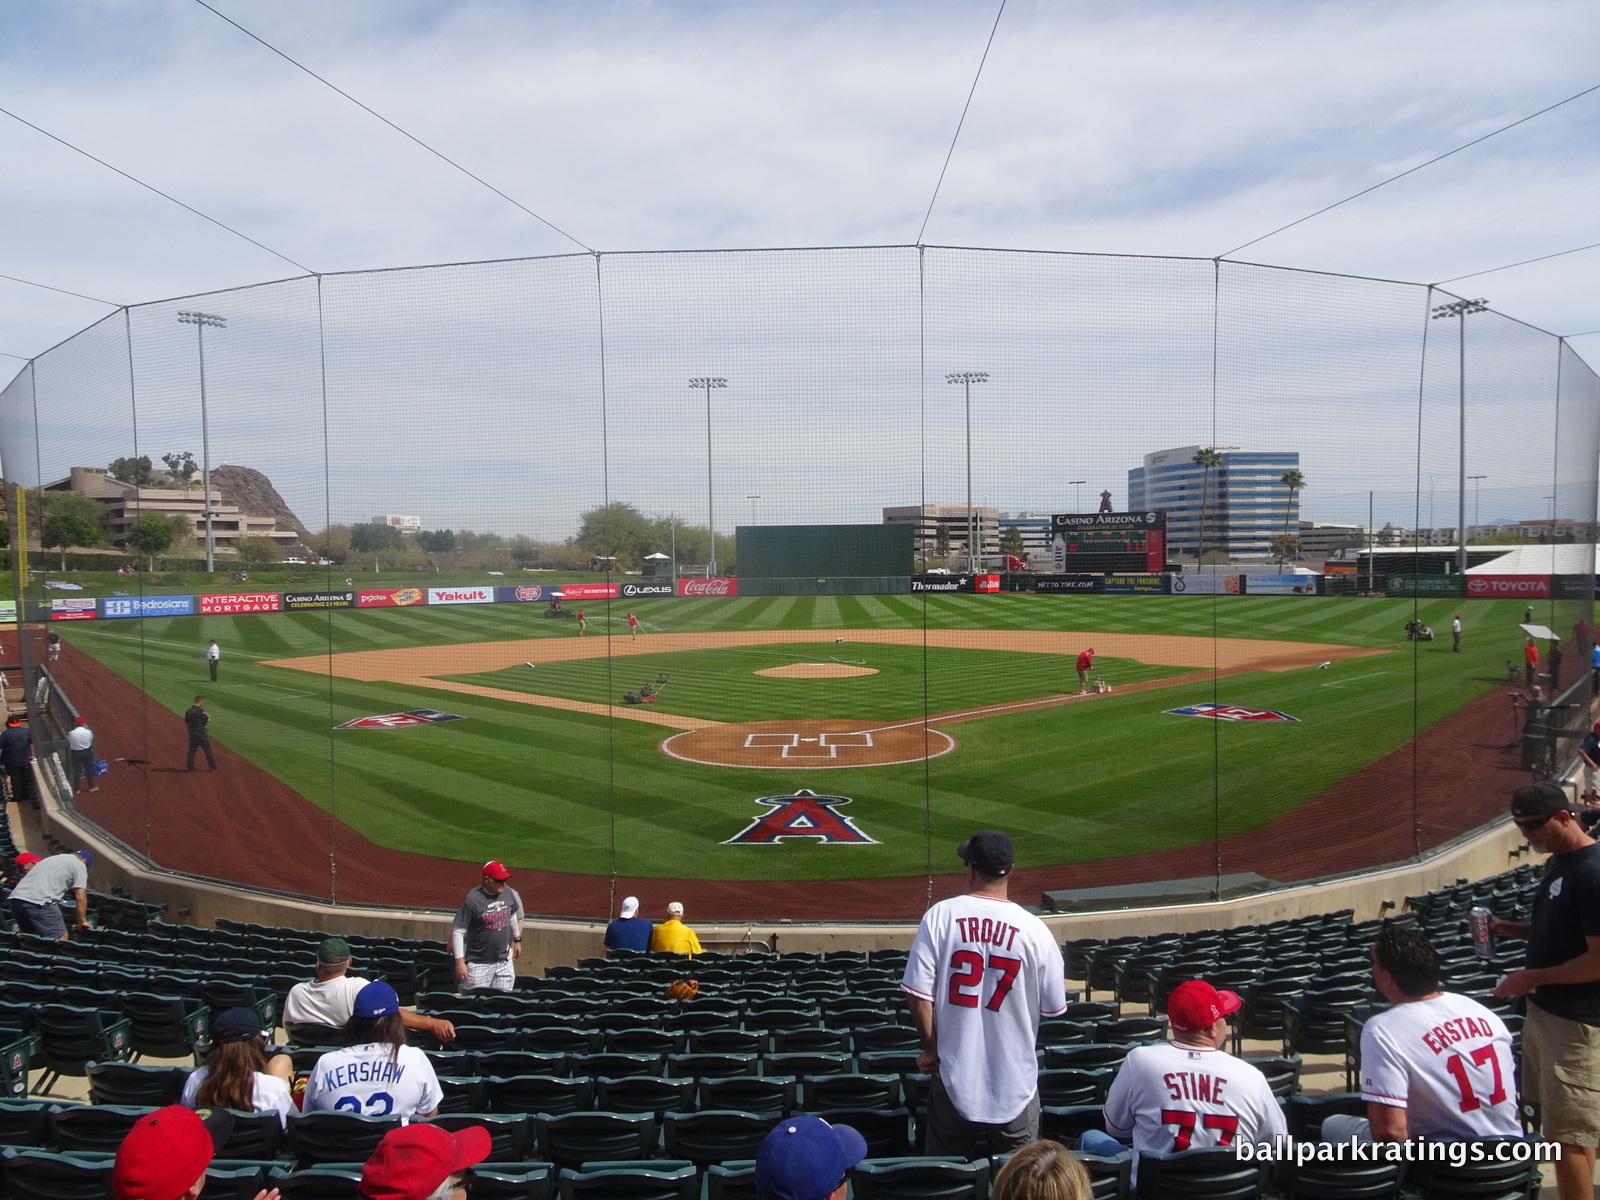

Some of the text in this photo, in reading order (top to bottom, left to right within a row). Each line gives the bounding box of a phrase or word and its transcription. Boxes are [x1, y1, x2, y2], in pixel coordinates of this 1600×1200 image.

[1056, 514, 1142, 525] CASINO ARIZONA
[636, 586, 672, 594] LEXUS
[684, 580, 731, 596] Coca-Cola
[912, 581, 959, 591] Thermador
[1491, 581, 1547, 592] TOYOTA
[202, 595, 278, 605] INTERACTIVE
[285, 595, 312, 603] CASINO
[396, 590, 415, 599] nutter
[435, 590, 487, 601] Yakult
[133, 600, 189, 610] Bedrosians
[202, 603, 278, 613] MORTGAGE
[955, 917, 1020, 952] TROUT
[948, 949, 1022, 1013] 27
[1422, 1016, 1494, 1056] ERSTAD
[325, 1061, 406, 1092] KERSHAW
[1446, 1043, 1507, 1114] 17
[1163, 1072, 1228, 1106] STINE
[1161, 1109, 1239, 1153] 77
